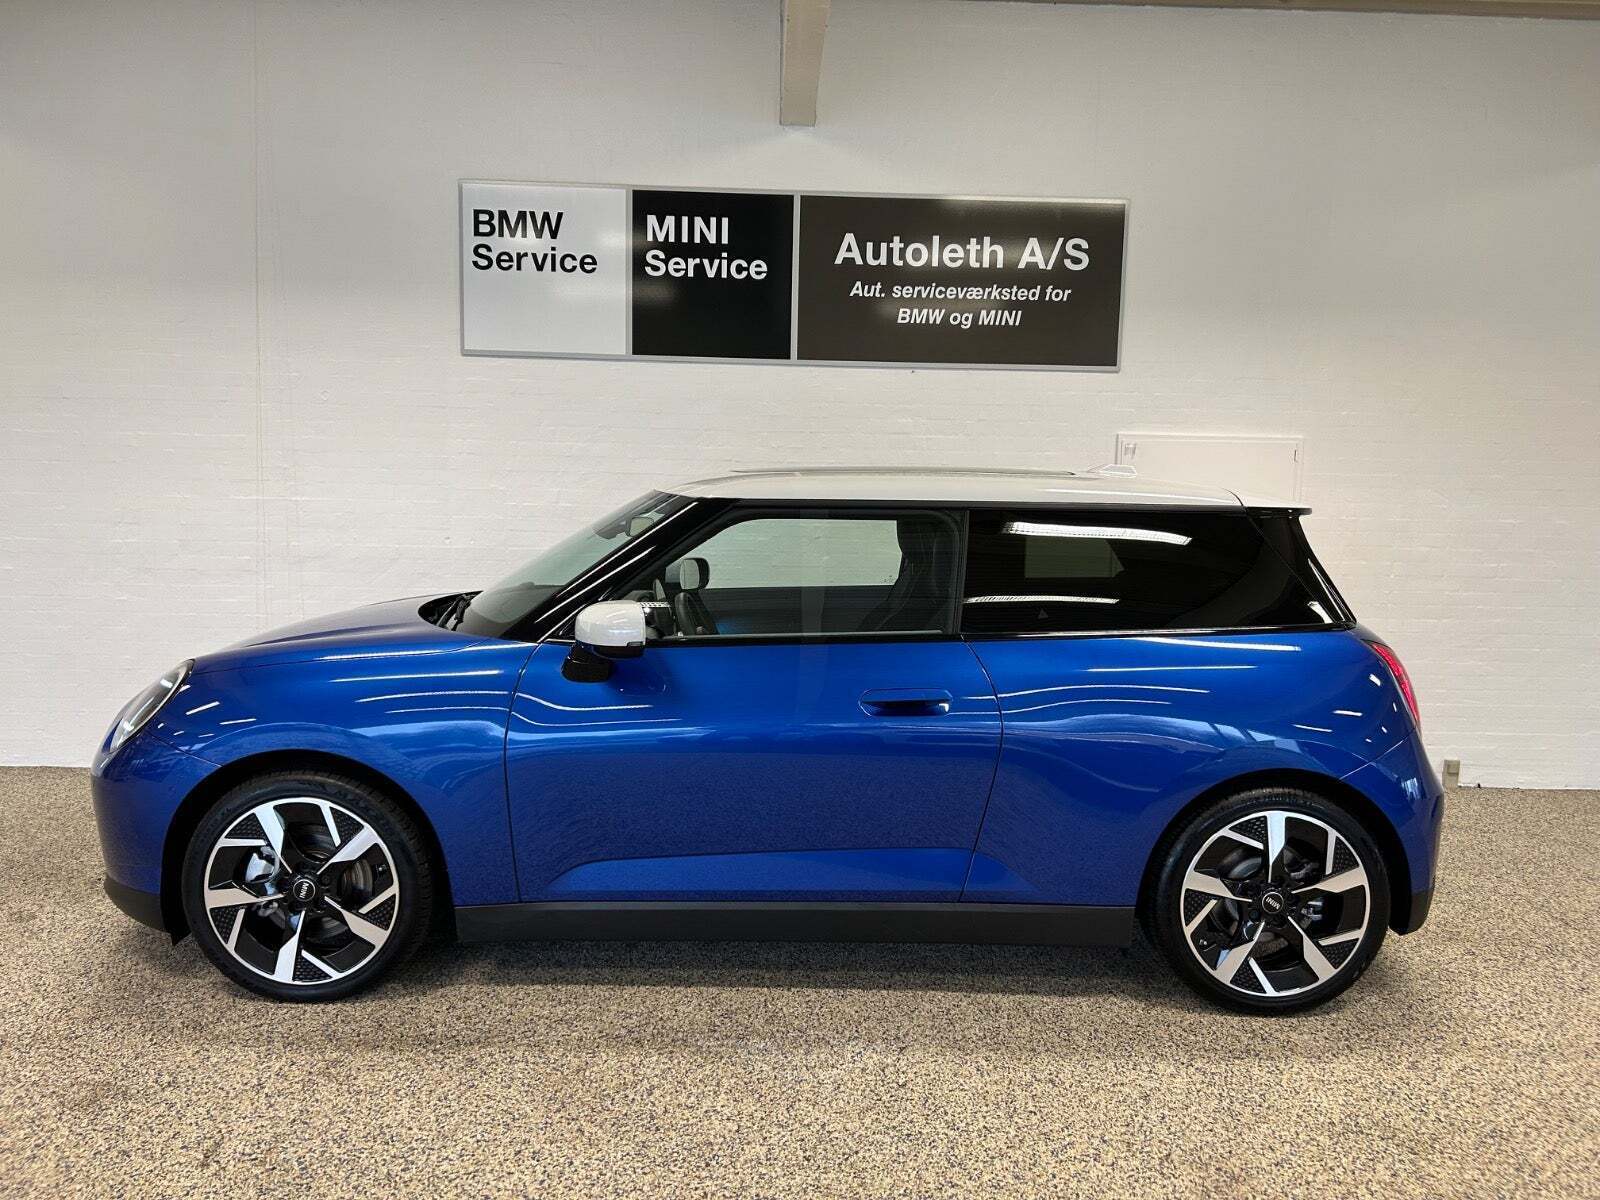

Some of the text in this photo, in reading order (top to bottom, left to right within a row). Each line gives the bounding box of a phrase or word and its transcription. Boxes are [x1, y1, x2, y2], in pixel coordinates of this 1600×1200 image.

[472, 208, 564, 240] BMW
[646, 214, 729, 245] MINI
[471, 243, 598, 274] Service
[644, 249, 768, 280] Service
[834, 232, 1090, 271] Autoleth A/S
[849, 281, 1072, 302] Aut. serviceværksted for
[896, 308, 1023, 329] BMW og MINI
